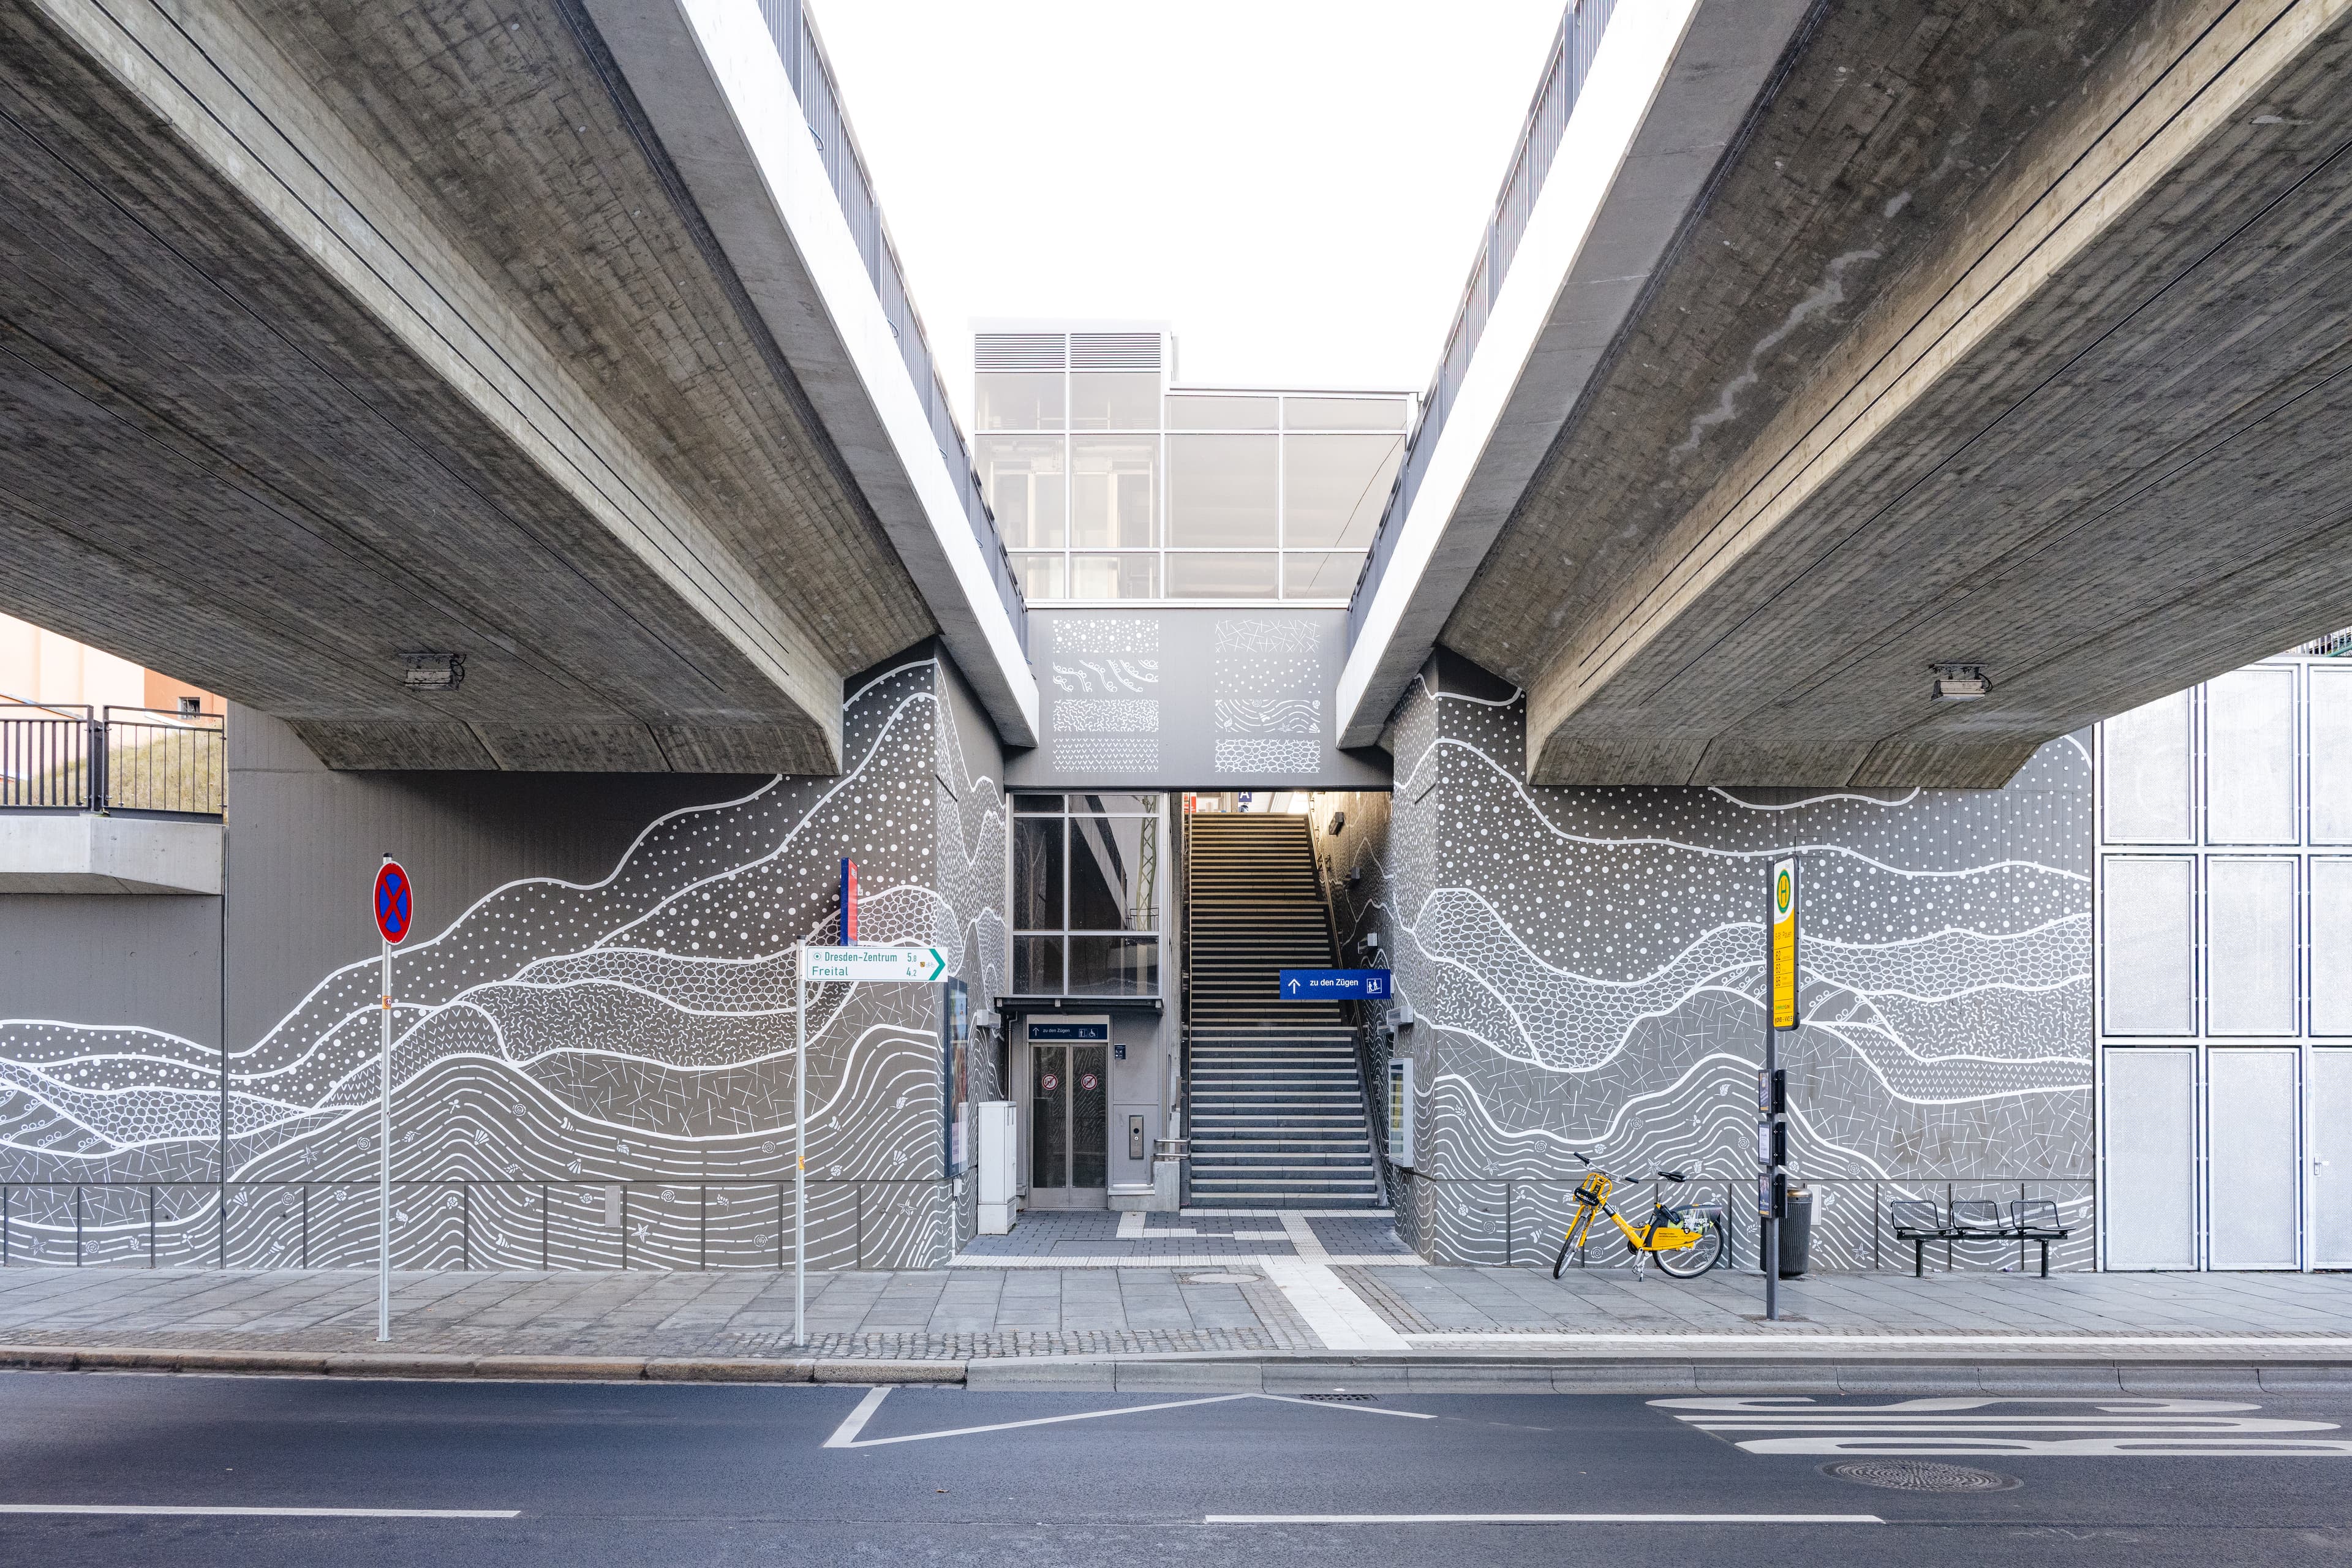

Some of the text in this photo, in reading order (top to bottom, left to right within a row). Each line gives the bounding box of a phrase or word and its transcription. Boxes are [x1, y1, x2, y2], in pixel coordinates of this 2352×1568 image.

[825, 952, 917, 962] Dresden-Zentrum 5.8
[1776, 950, 1781, 961] 62
[812, 966, 917, 976] Freital 4.2
[1776, 963, 1781, 973] 63
[1336, 979, 1358, 987] Zügen
